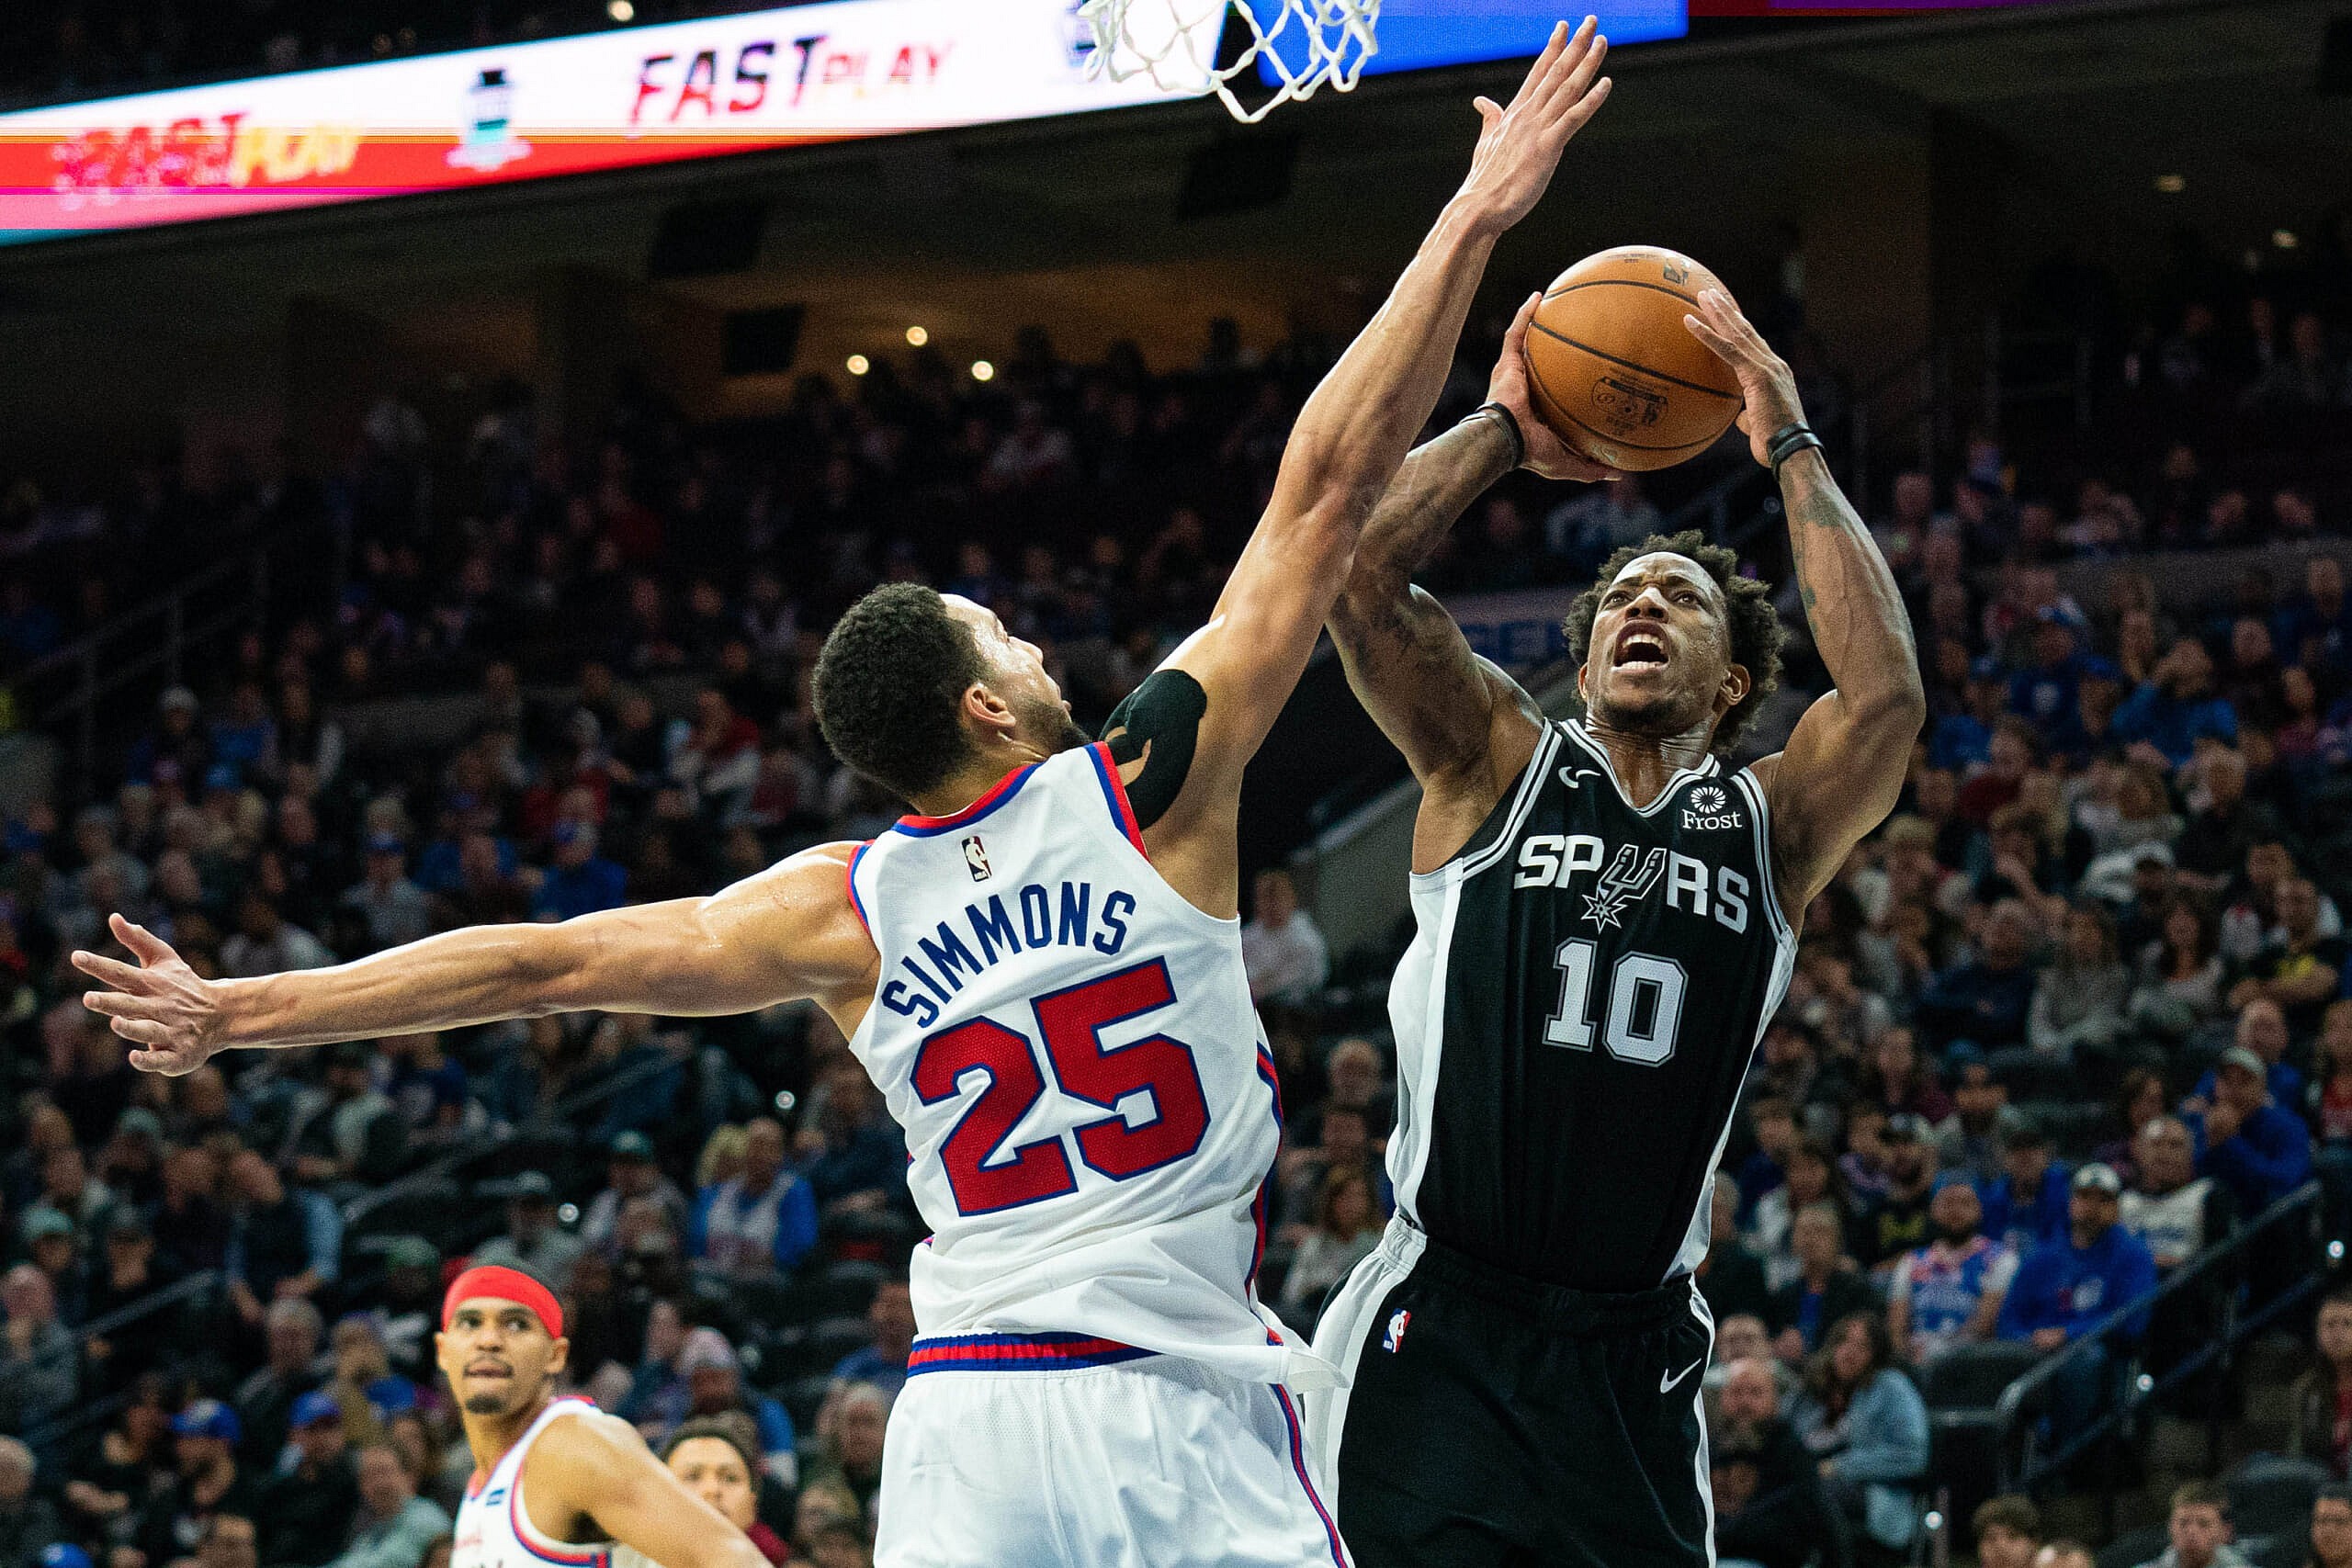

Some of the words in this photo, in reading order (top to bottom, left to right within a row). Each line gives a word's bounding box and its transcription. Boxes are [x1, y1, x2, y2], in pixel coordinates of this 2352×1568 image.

[1513, 834, 1749, 934] SPURS
[1681, 808, 1743, 829] Frost
[880, 881, 1136, 1029] SIMMONS
[1542, 936, 1689, 1068] 10
[910, 954, 1211, 1218] 25
